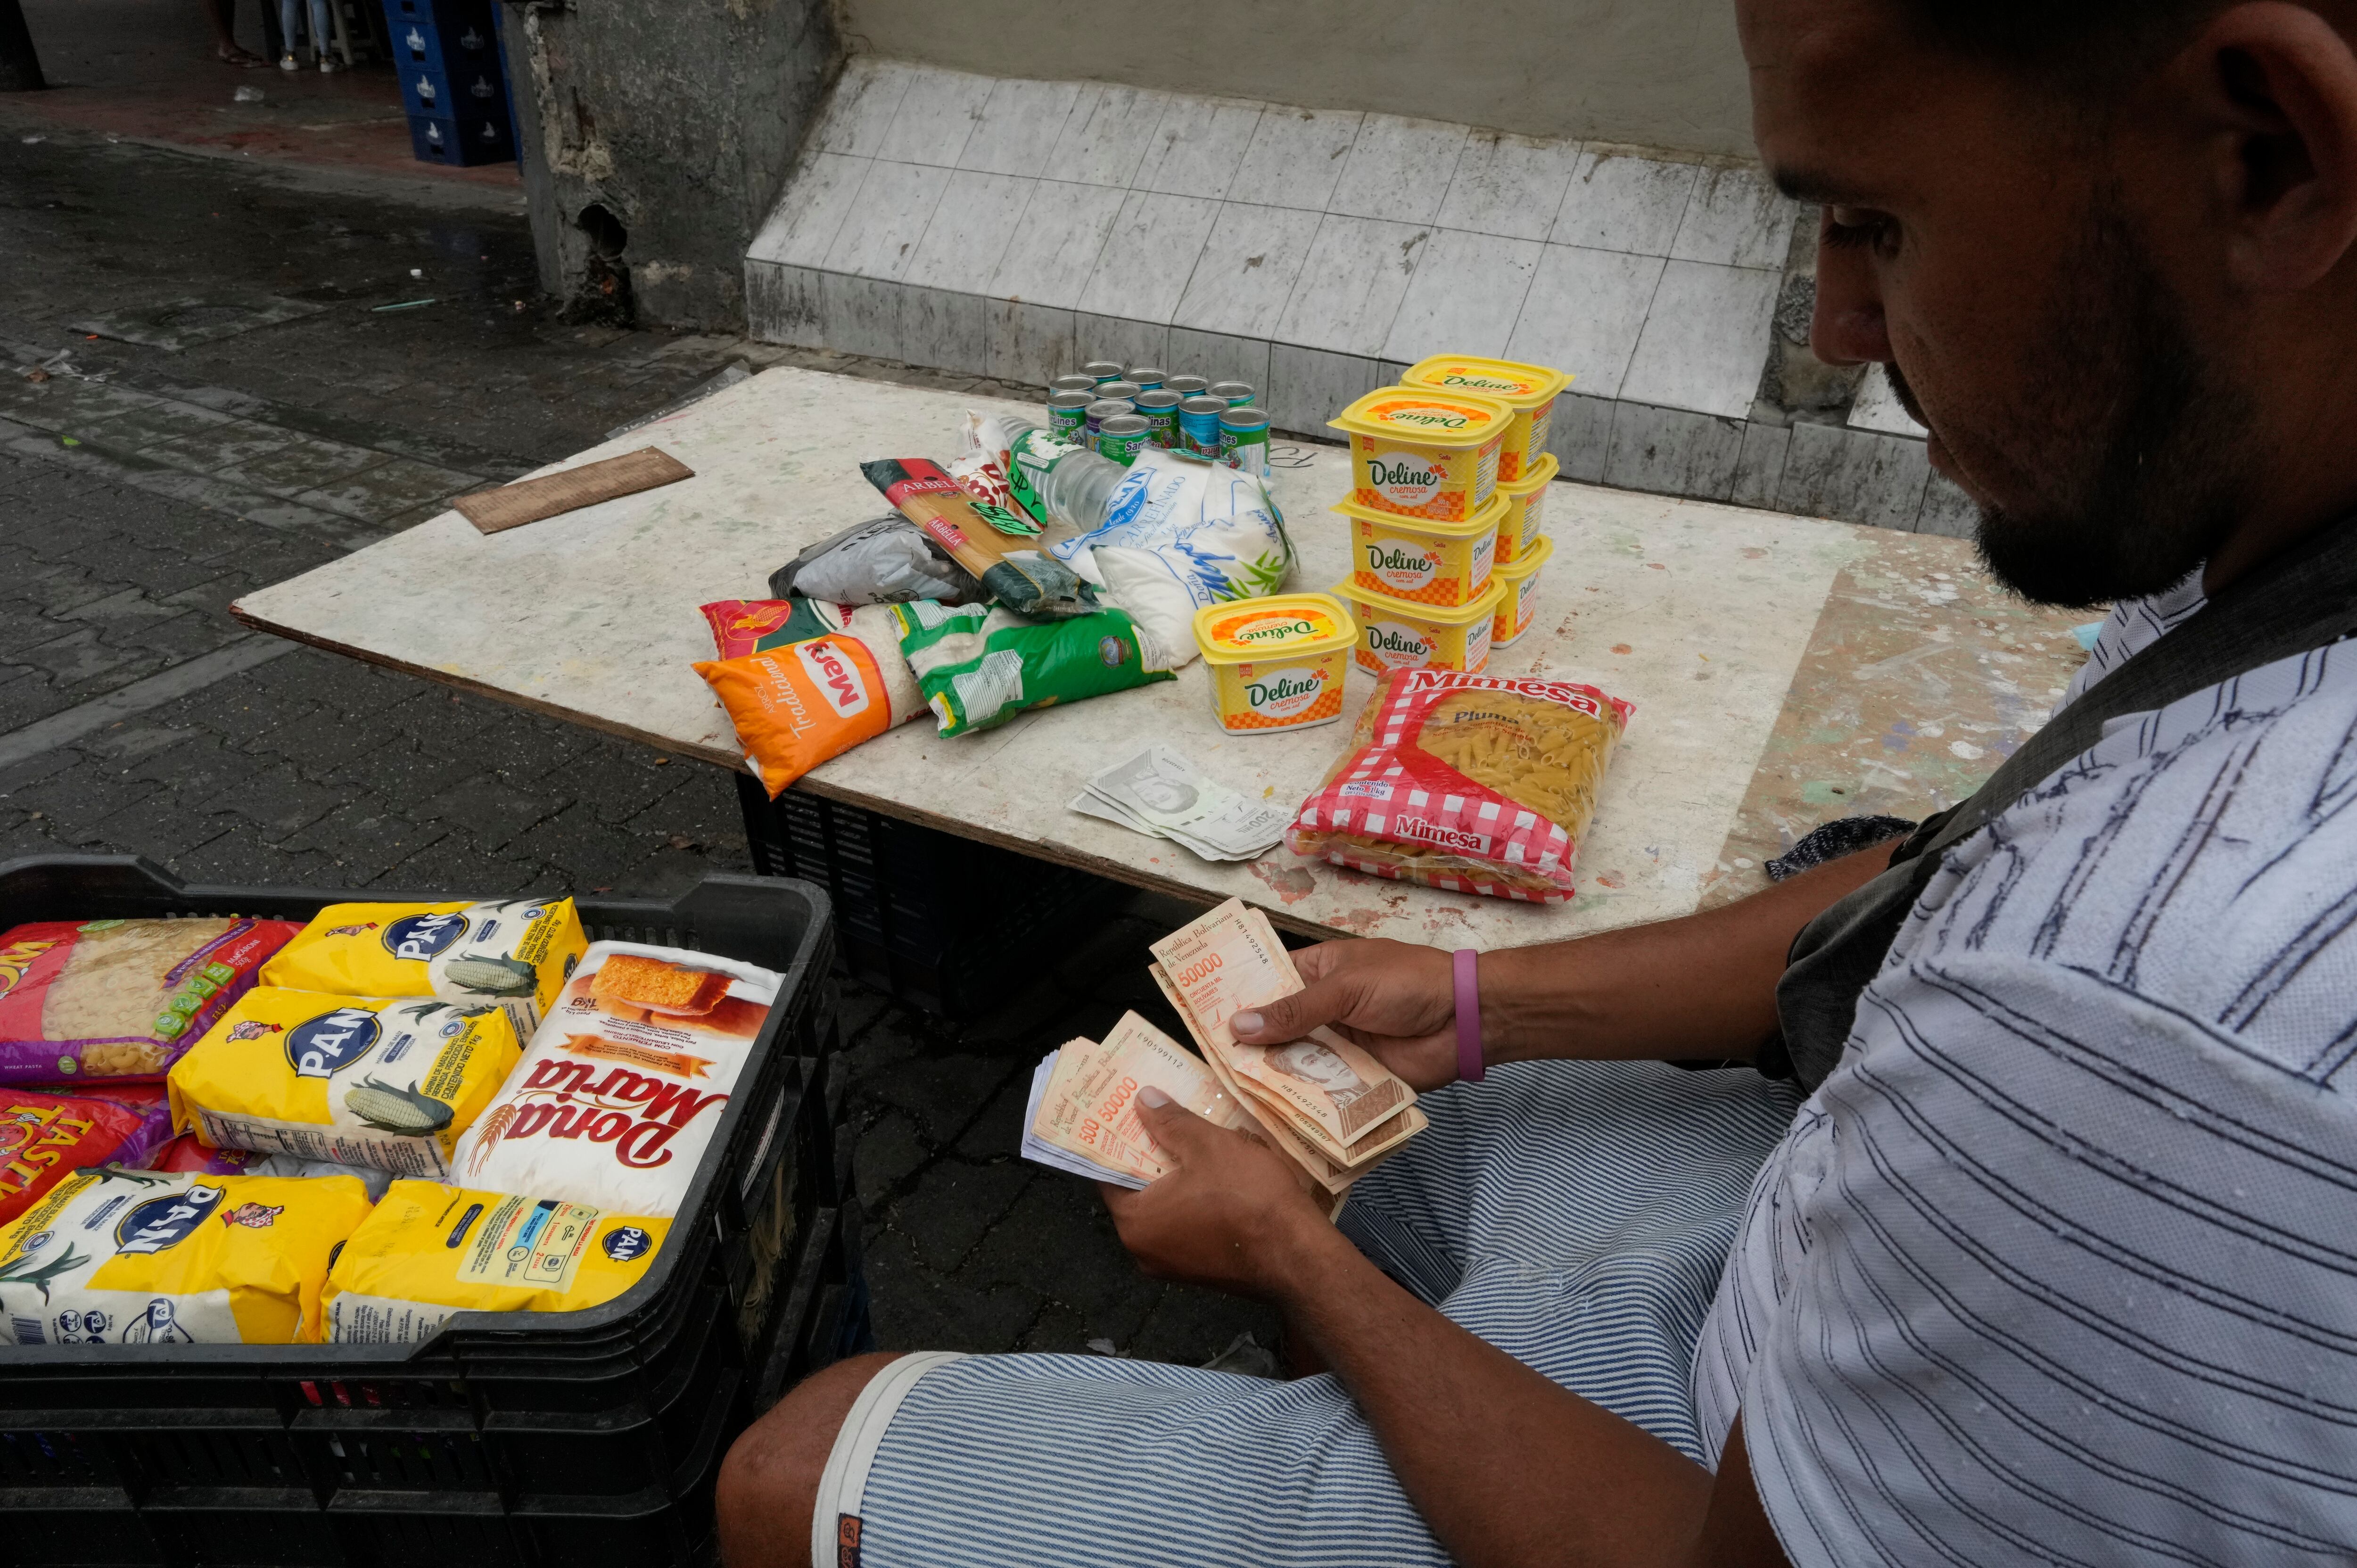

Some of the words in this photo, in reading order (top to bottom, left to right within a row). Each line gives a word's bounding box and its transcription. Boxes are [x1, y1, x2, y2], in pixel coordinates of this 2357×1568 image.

[1443, 375, 1518, 390] Deline
[1048, 415, 1077, 426] ardines
[1389, 413, 1468, 429] Deline
[1438, 453, 1451, 461] Sadia
[1366, 460, 1437, 486] Deline
[1390, 486, 1428, 494] cremosa
[928, 519, 964, 547] ARBELLA
[1365, 545, 1432, 572] Deline
[1473, 536, 1493, 561] Deline
[1386, 570, 1423, 579] cremosa
[1187, 573, 1209, 602] Doña
[1239, 621, 1319, 640] Deline
[1246, 621, 1288, 632] cremosa
[1467, 621, 1489, 646] Deline
[1365, 626, 1427, 655] Deline
[1385, 652, 1419, 661] cremosa
[750, 656, 816, 740] Tradicional
[754, 683, 777, 714] ARROZ
[1244, 678, 1319, 707] Deline
[1269, 692, 1311, 710] cremosa
[1414, 670, 1601, 717] Mimesa
[1454, 710, 1519, 725] Pluma
[834, 741, 854, 754] ARROZ
[1235, 824, 1250, 834] MIL
[1248, 810, 1275, 829] 200
[1395, 814, 1482, 850] Mimesa
[480, 924, 492, 937] BLANCO
[530, 919, 542, 933] BLANCO
[1158, 936, 1192, 958] República
[1193, 912, 1234, 939] Bolivariana
[227, 939, 260, 964] MACARONI
[531, 937, 550, 965] CONTENIDO
[545, 926, 556, 940] NETO
[552, 918, 561, 927] 1kg
[1234, 918, 1269, 965] H81492548
[1167, 959, 1177, 969] de
[1174, 940, 1209, 963] Venezuela
[1177, 952, 1223, 988] 50000
[1189, 981, 1215, 999] CINCUENTA
[1214, 976, 1223, 986] MIL
[1193, 987, 1219, 1005] BOLÍVARES
[570, 994, 598, 1010] 1kg
[389, 1039, 406, 1056] BLANCO
[396, 1036, 417, 1061] PRECOCIDA
[613, 1033, 652, 1046] FERMENTO
[374, 1047, 390, 1064] HARINA
[423, 1075, 439, 1095] HARINA
[433, 1067, 442, 1075] DE
[444, 1037, 459, 1055] BLANCO
[639, 1056, 663, 1065] FARINHA
[1071, 1070, 1100, 1100] República
[1098, 1028, 1134, 1067] Bolivariana
[440, 1062, 466, 1100] CONTENIDO
[460, 1045, 474, 1063] NETO
[468, 1034, 482, 1047] 1kg
[521, 1059, 729, 1129] Maria
[1081, 1098, 1093, 1109] de
[1097, 1076, 1138, 1122] 50000
[1281, 1084, 1328, 1119] H81492548
[1050, 1098, 1069, 1129] República
[1078, 1117, 1100, 1145] 500
[32, 1207, 59, 1233] BLANCO
[504, 1215, 519, 1232] PREPARAR
[8, 1223, 25, 1243] 1kg
[542, 1225, 557, 1246] CUCHARADITA
[579, 1225, 592, 1242] PREPARAR
[572, 1246, 581, 1256] MASA
[531, 1256, 542, 1269] TAZAS
